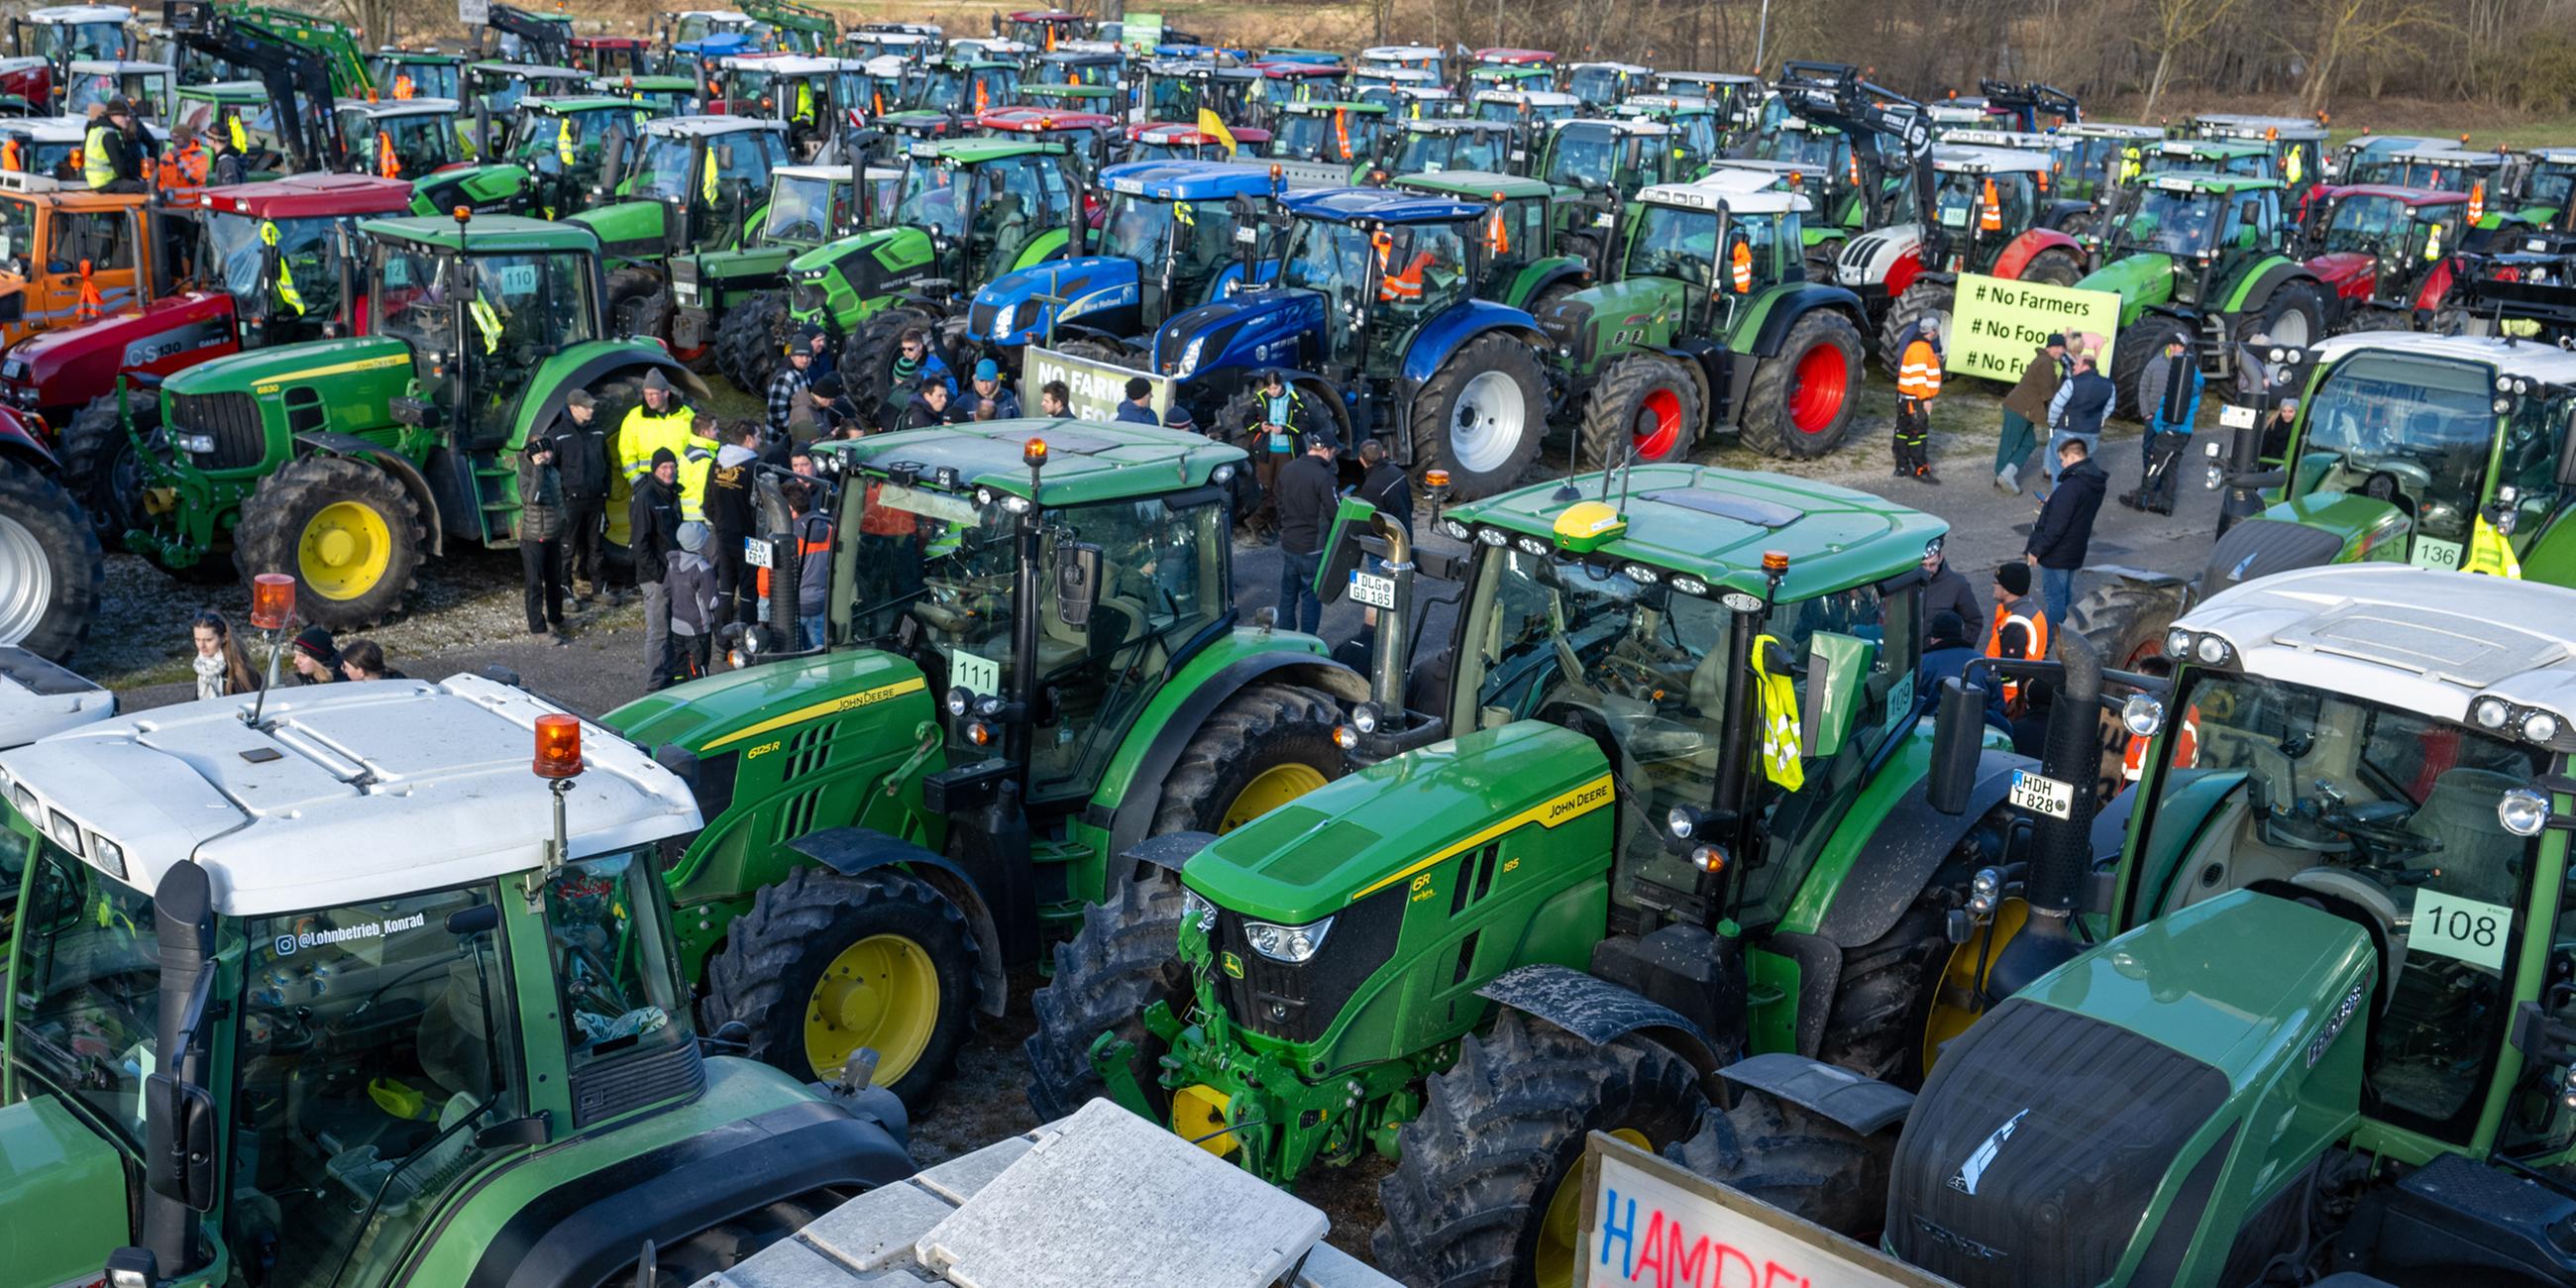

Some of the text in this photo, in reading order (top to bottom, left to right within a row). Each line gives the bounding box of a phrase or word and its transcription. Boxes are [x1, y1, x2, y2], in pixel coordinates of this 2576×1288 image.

[505, 269, 533, 286] 110
[1990, 287, 2015, 306] No
[2019, 291, 2091, 316] Farmers
[1986, 320, 2010, 339] No
[2014, 325, 2058, 345] Foo
[1037, 362, 1066, 384] NO
[1981, 353, 2005, 372] No
[2009, 358, 2029, 376] Fu
[2421, 544, 2457, 566] 136
[1361, 575, 1382, 591] DLG
[1353, 587, 1391, 606] GD 185
[959, 661, 991, 689] 111
[838, 689, 896, 711] JOHN DEERE
[1890, 682, 1911, 715] 109
[2023, 776, 2053, 796] HDH
[1549, 786, 1609, 819] JOHN DEERE
[2015, 789, 2054, 813] T 828
[1503, 857, 1520, 873] 185
[1412, 873, 1432, 892] 6R
[298, 912, 426, 948] @Lohnbetrieb_Konrad
[2427, 906, 2497, 947] 108
